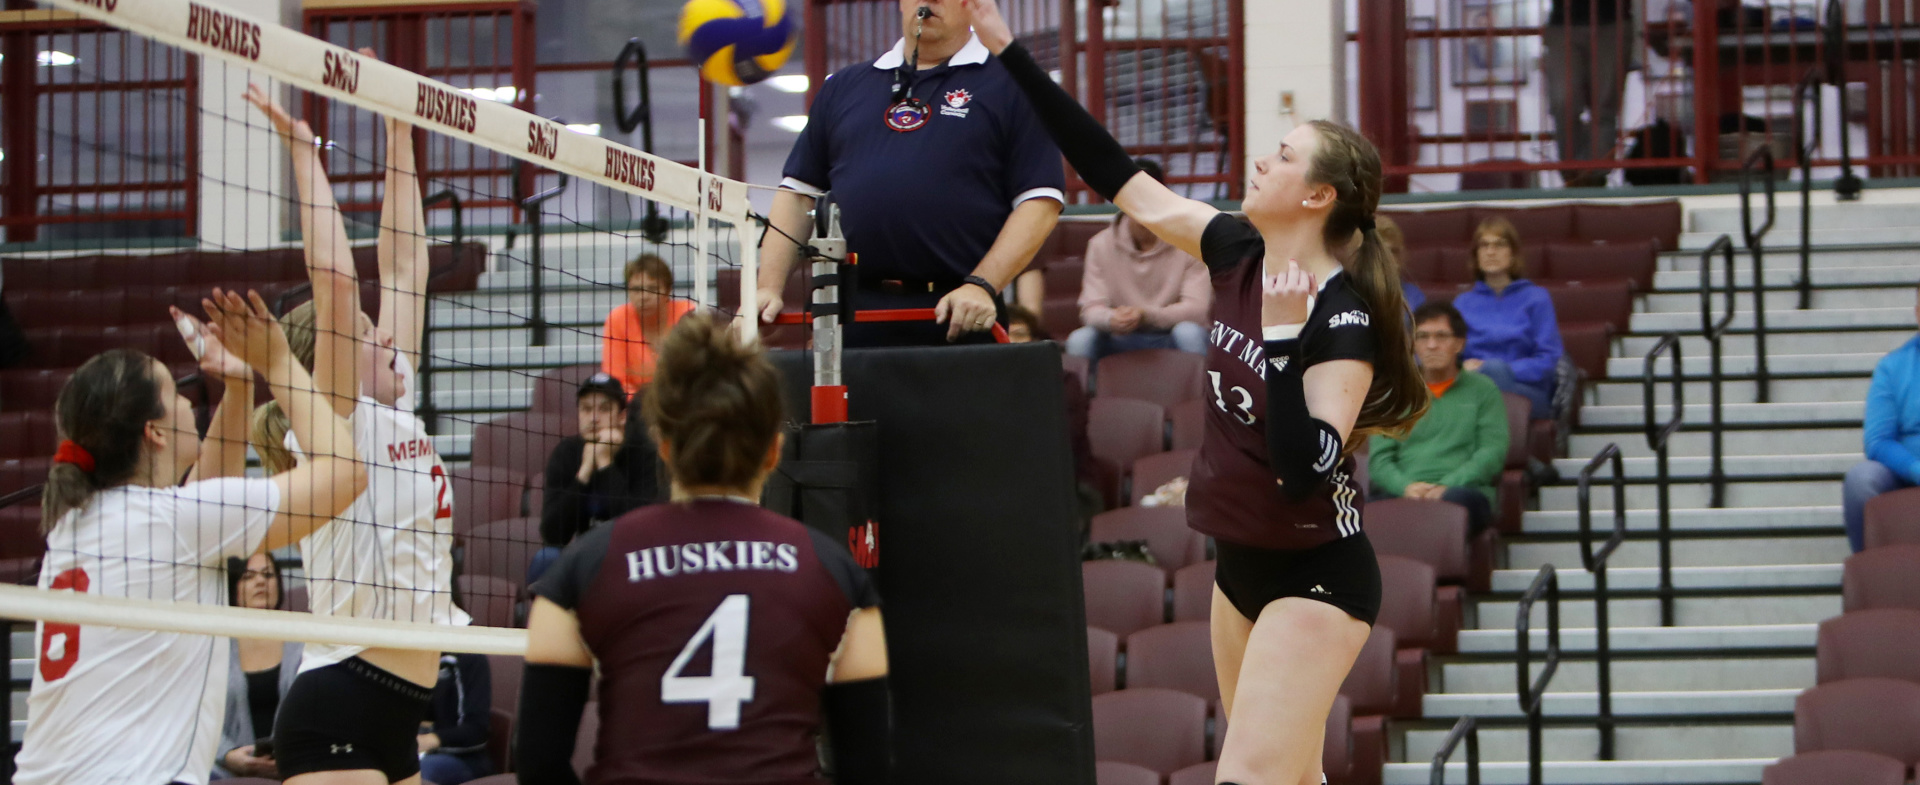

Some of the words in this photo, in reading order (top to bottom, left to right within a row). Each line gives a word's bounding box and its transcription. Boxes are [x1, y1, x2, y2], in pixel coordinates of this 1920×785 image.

[187, 1, 261, 61] HUSKIES
[322, 50, 360, 94] SMU
[416, 82, 477, 134] HUSKIES
[528, 120, 558, 160] SMU
[605, 146, 656, 192] HUSKIES
[1328, 309, 1370, 328] SMU
[1207, 370, 1257, 425] 13
[387, 438, 436, 462] MEM
[430, 465, 451, 520] 2
[625, 540, 799, 583] HUSKIES
[661, 593, 755, 730] 4
